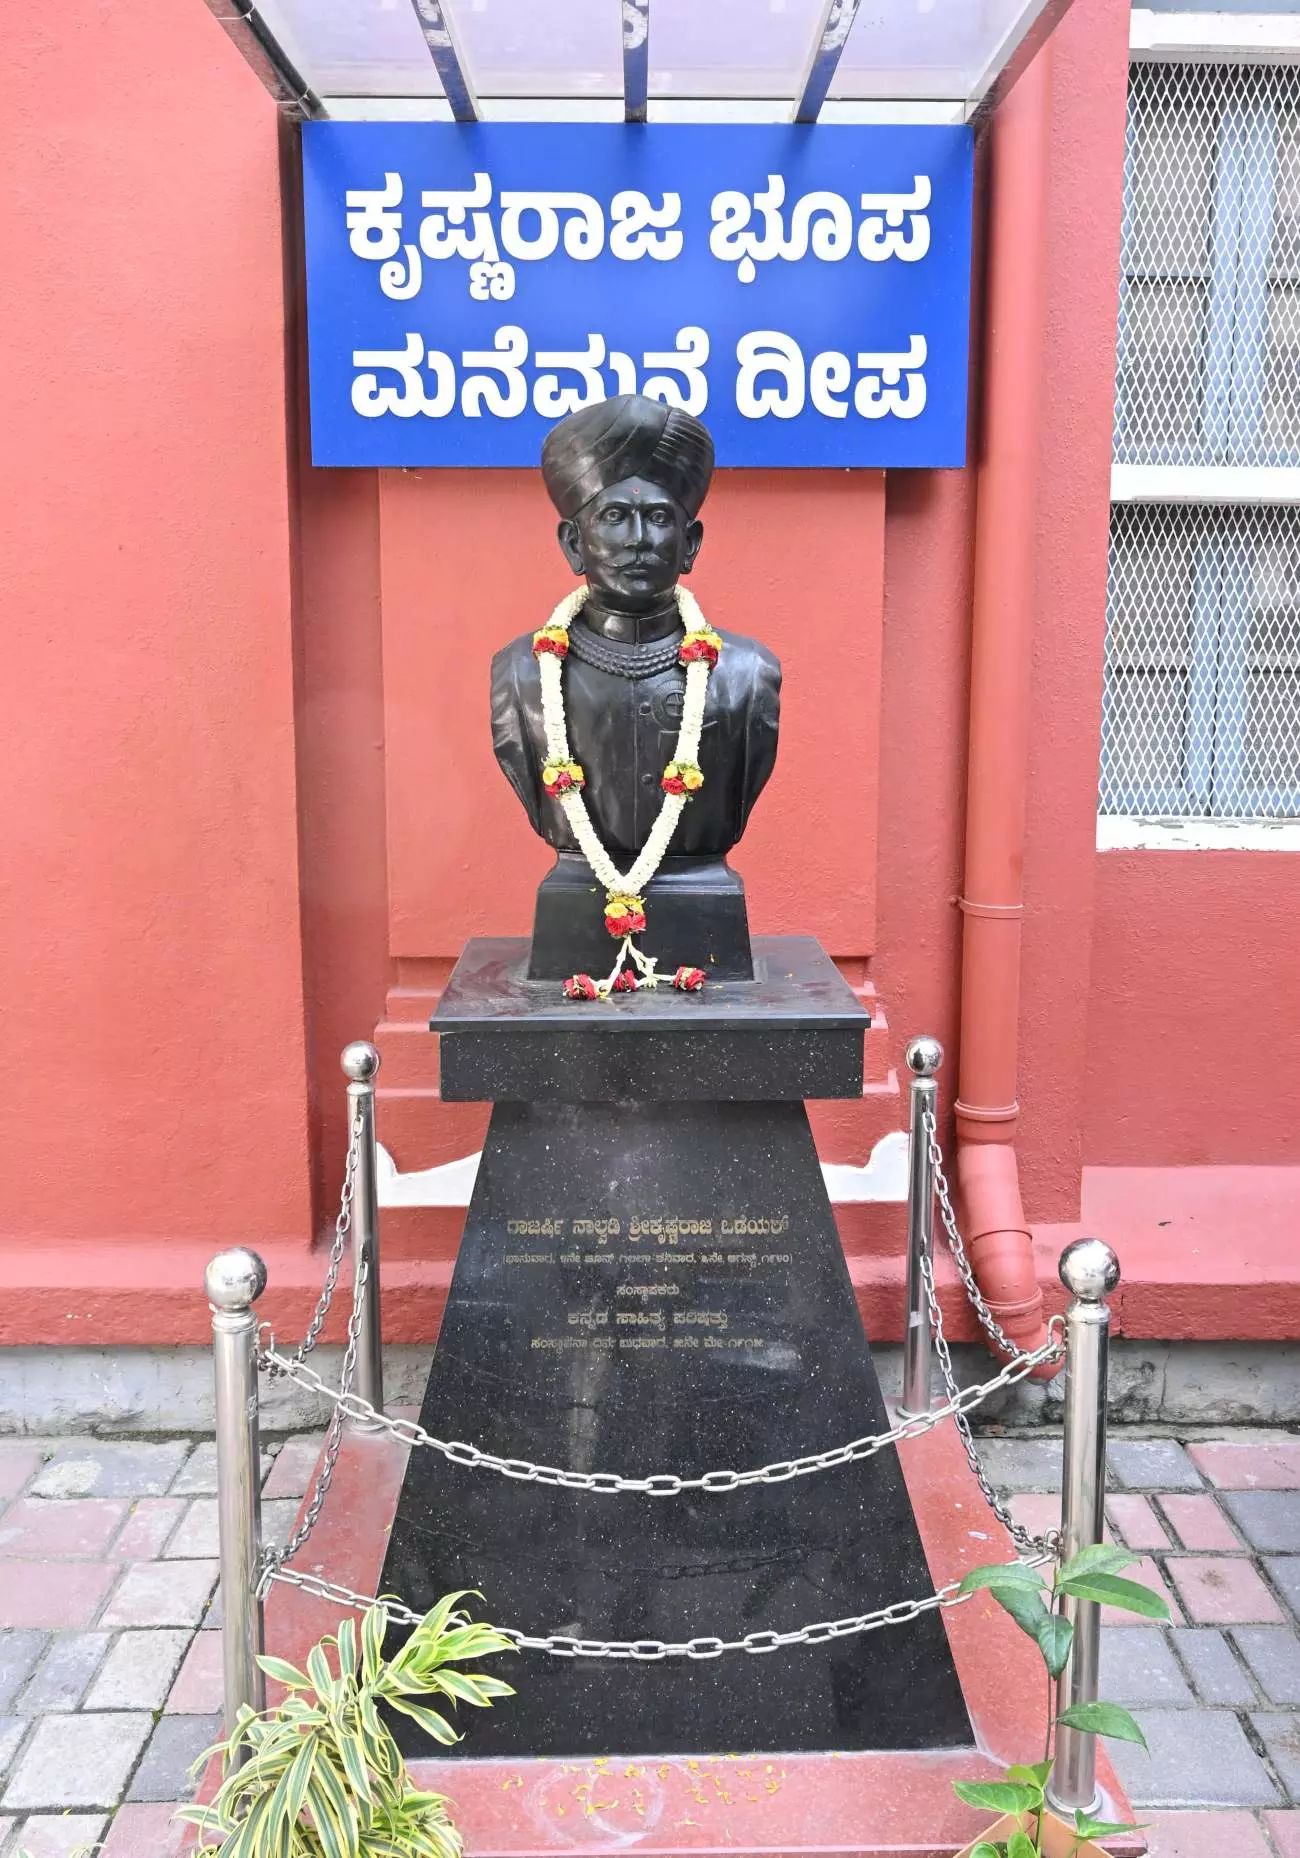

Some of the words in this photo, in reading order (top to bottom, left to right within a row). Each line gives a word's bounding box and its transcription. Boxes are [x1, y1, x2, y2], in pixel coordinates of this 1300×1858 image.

[346, 173, 683, 300] ಕೃಷ್ಣರಾಜ
[710, 175, 931, 284] ಭೂಪ
[351, 326, 709, 418] ಮನೆಮನೆ
[736, 331, 927, 418] ದೀಪ
[507, 1218, 563, 1239] ರಾಜರ್ಷಿ
[573, 1218, 620, 1245] ನಾಲ್ವಡಿ
[628, 1216, 712, 1245] ಶ್ರೀಕೃಷ್ಣರಾಜ
[721, 1215, 789, 1235] ಒಡೆಯರ್
[616, 1284, 680, 1302] ಸಂಸ್ಥಾಪಕರು
[567, 1309, 609, 1330] ಕನ್ನಡ
[616, 1309, 665, 1331] ಸಾಹಿತ್ಯ
[673, 1310, 728, 1330] ಪರಿಷತ್ತು
